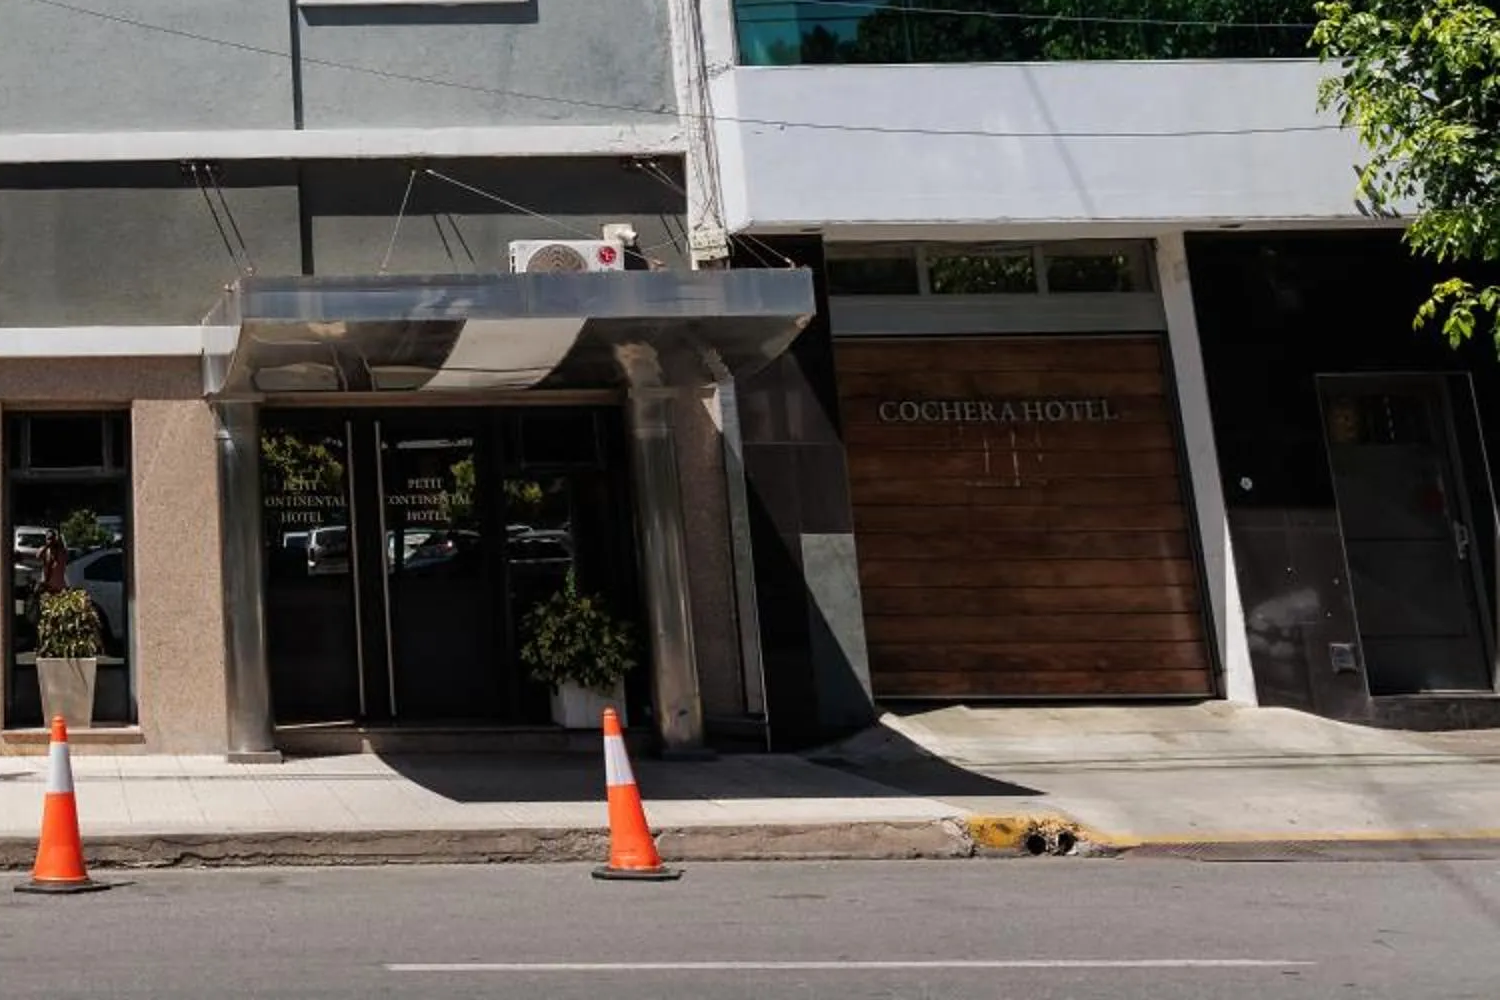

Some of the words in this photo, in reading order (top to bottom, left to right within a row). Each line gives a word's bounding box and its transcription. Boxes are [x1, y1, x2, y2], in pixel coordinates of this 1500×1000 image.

[878, 400, 1016, 422] COCHERA
[1023, 399, 1120, 422] HOTEL
[407, 478, 443, 489] PETIT
[264, 495, 348, 507] ONTINENTAL
[280, 511, 325, 523] HOTEL
[407, 511, 450, 522] HOTEL
